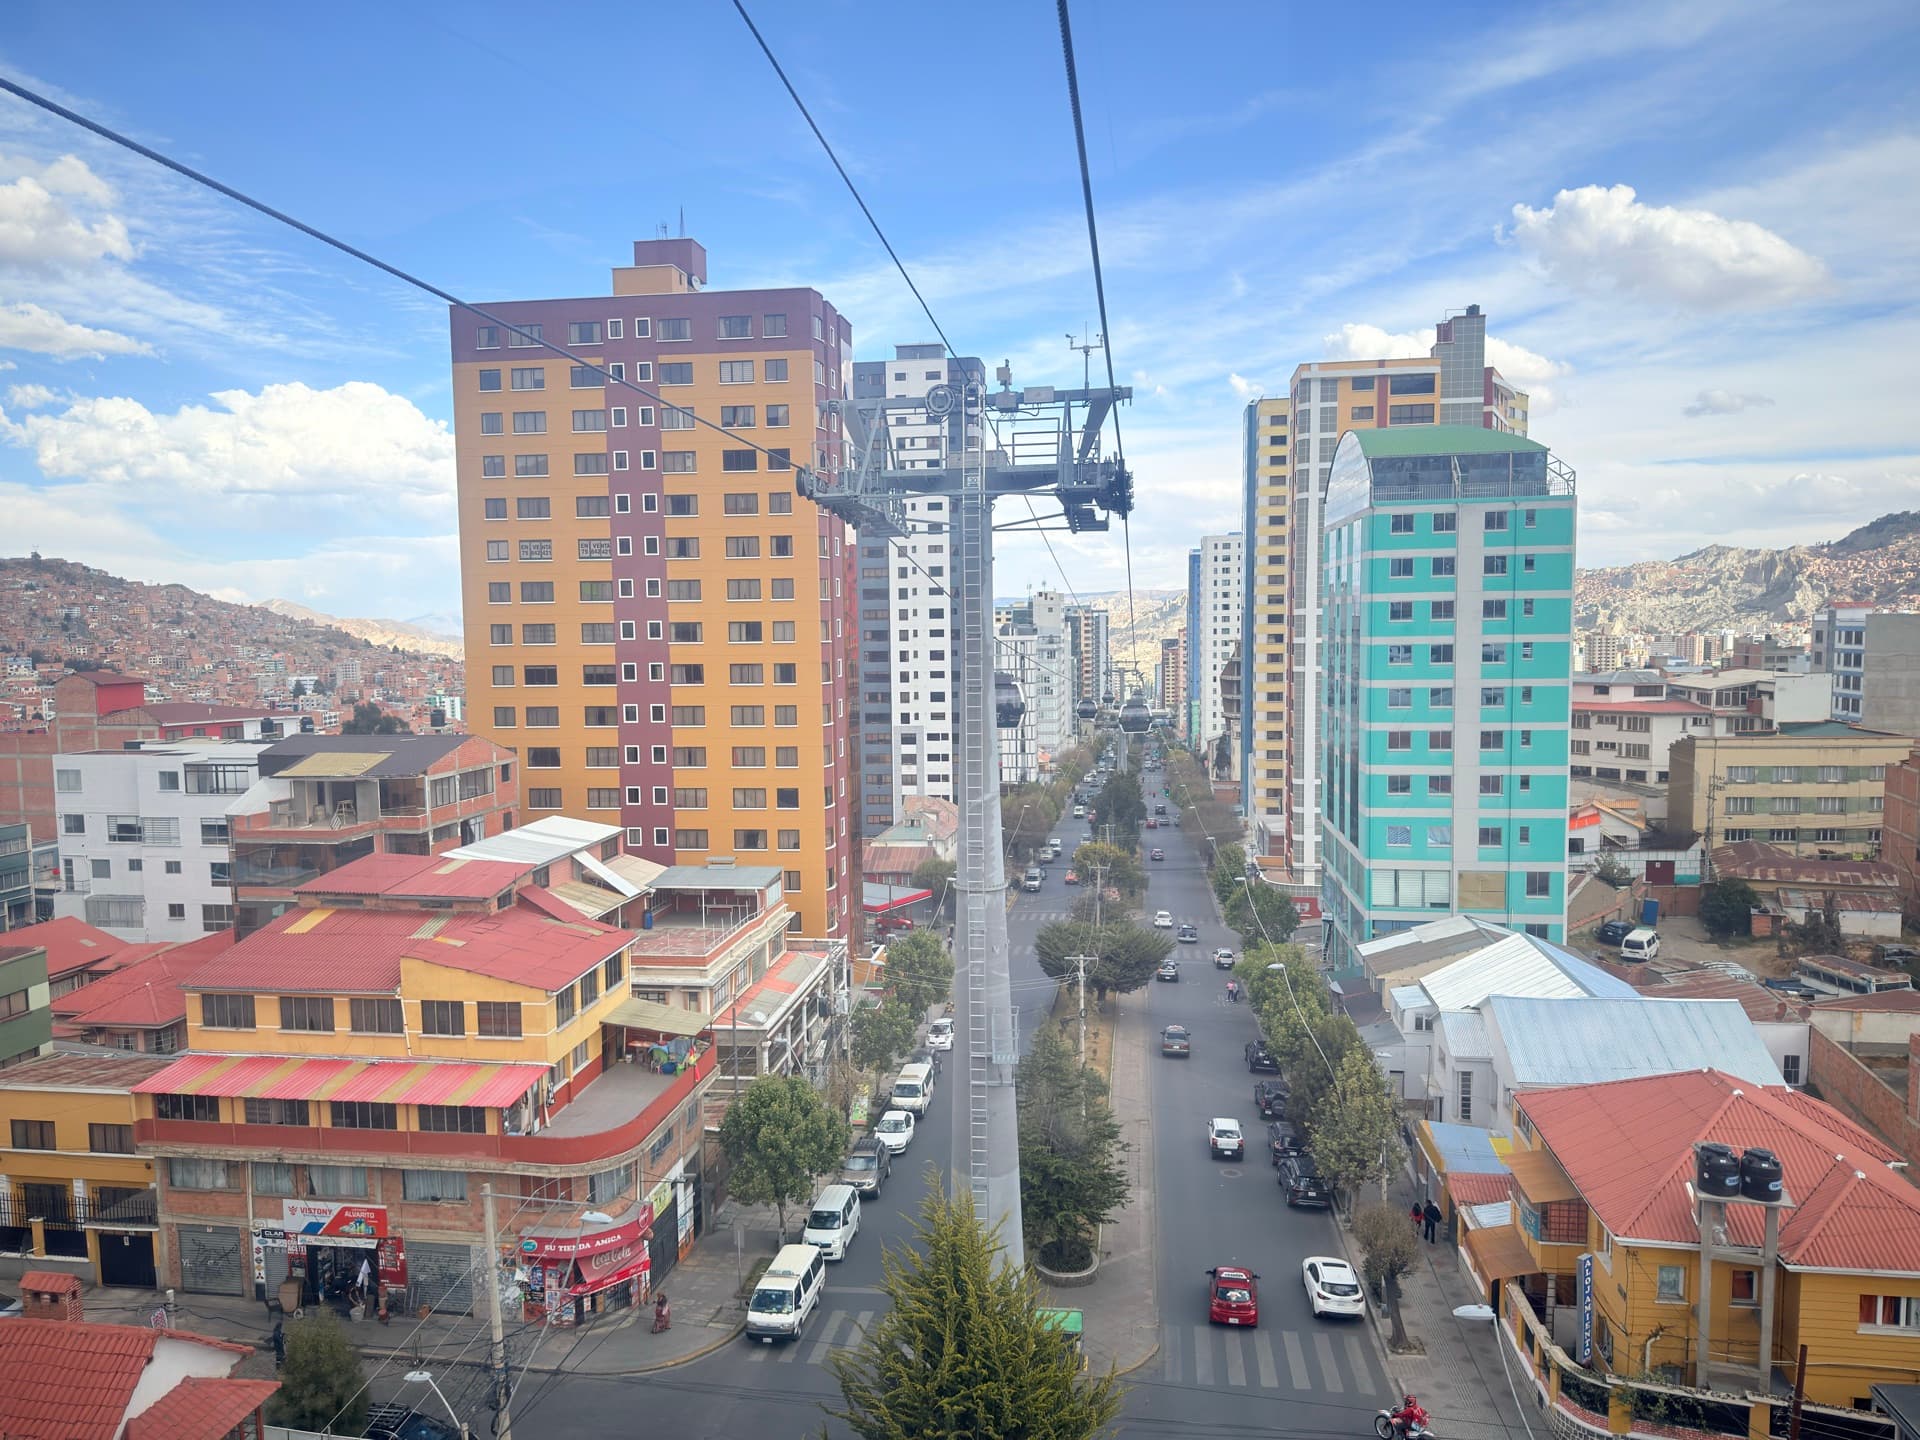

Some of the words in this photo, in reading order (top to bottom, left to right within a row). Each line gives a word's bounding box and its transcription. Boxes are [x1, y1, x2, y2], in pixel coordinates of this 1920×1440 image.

[300, 1207, 333, 1216] VISTONY
[344, 1211, 375, 1219] ALVARITO
[1584, 1259, 1592, 1356] ALOJAMIENTO
